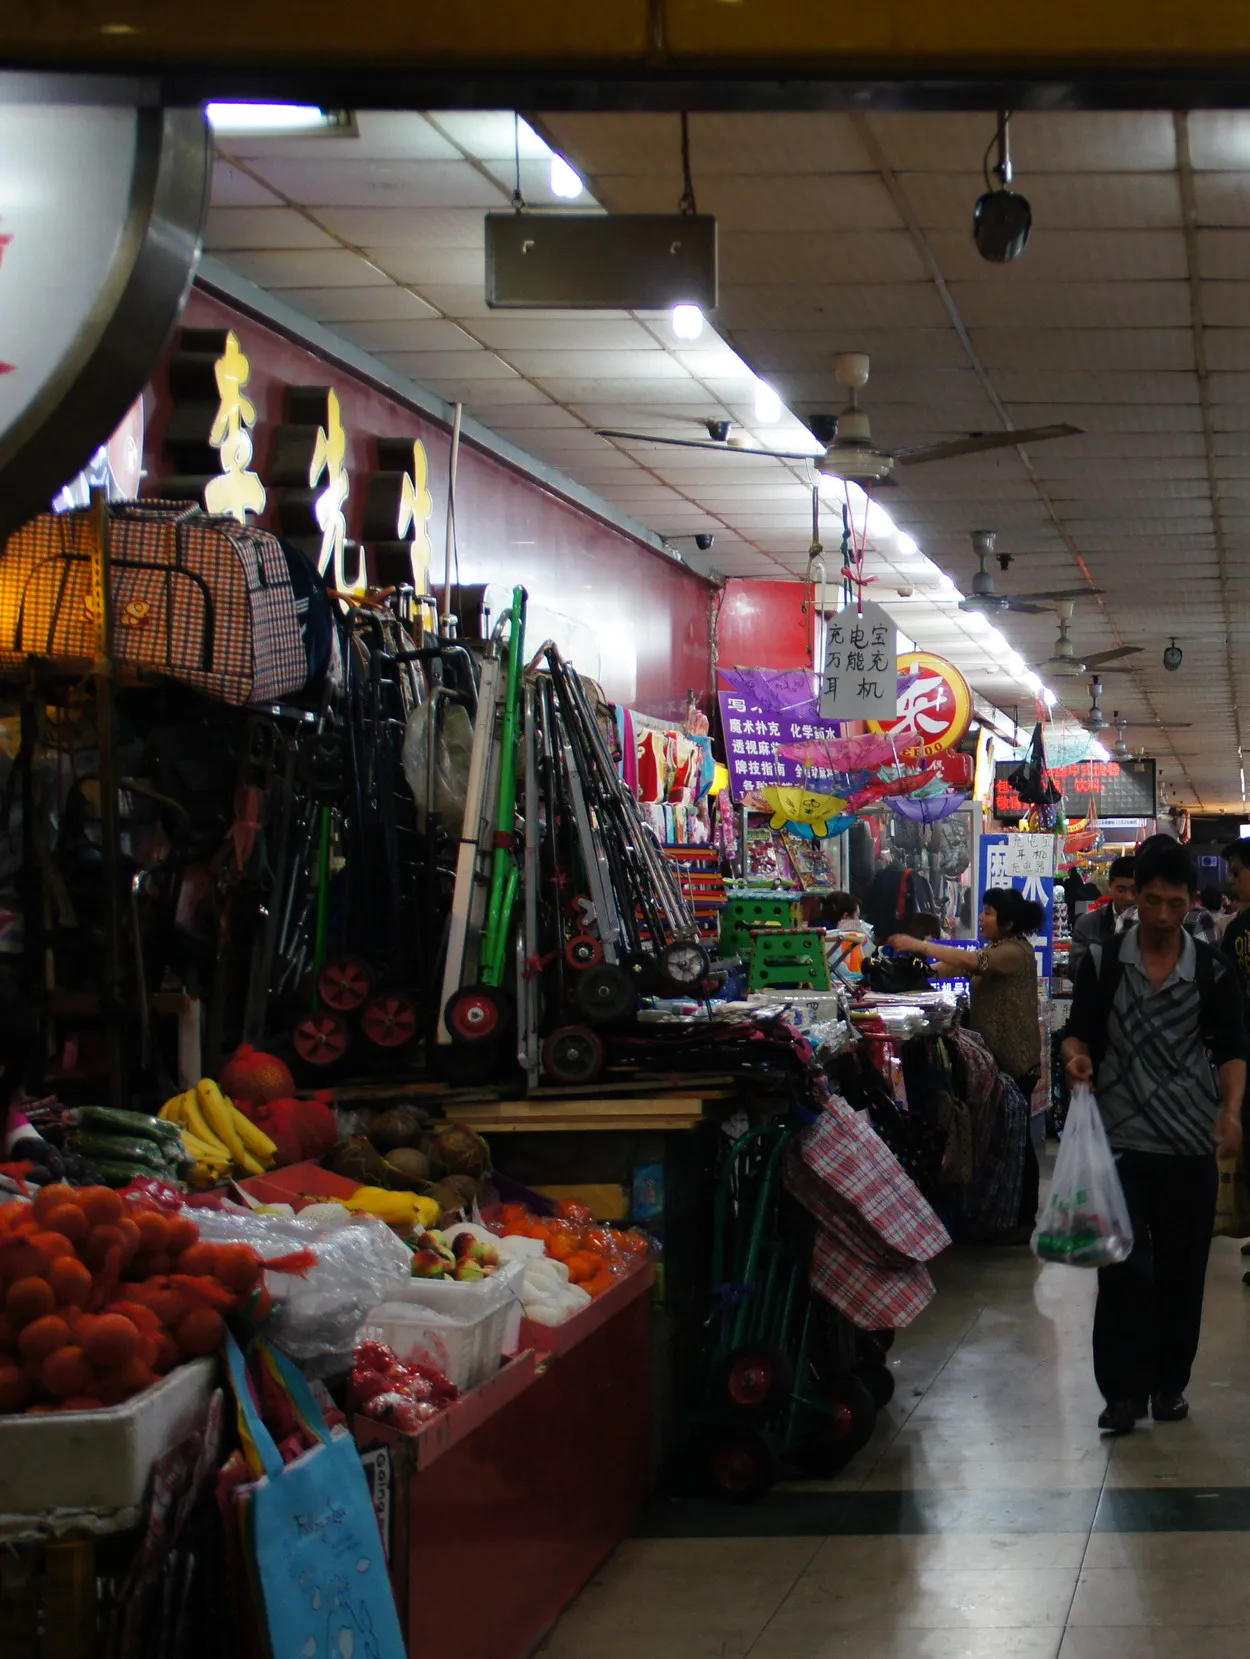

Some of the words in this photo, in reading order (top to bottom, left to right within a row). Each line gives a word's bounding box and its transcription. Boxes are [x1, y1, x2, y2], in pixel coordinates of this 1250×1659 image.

[828, 623, 889, 649] 充电宝
[826, 652, 889, 672] 万能充
[729, 719, 781, 736] 魔术扑克
[735, 760, 785, 777] 牌技指南
